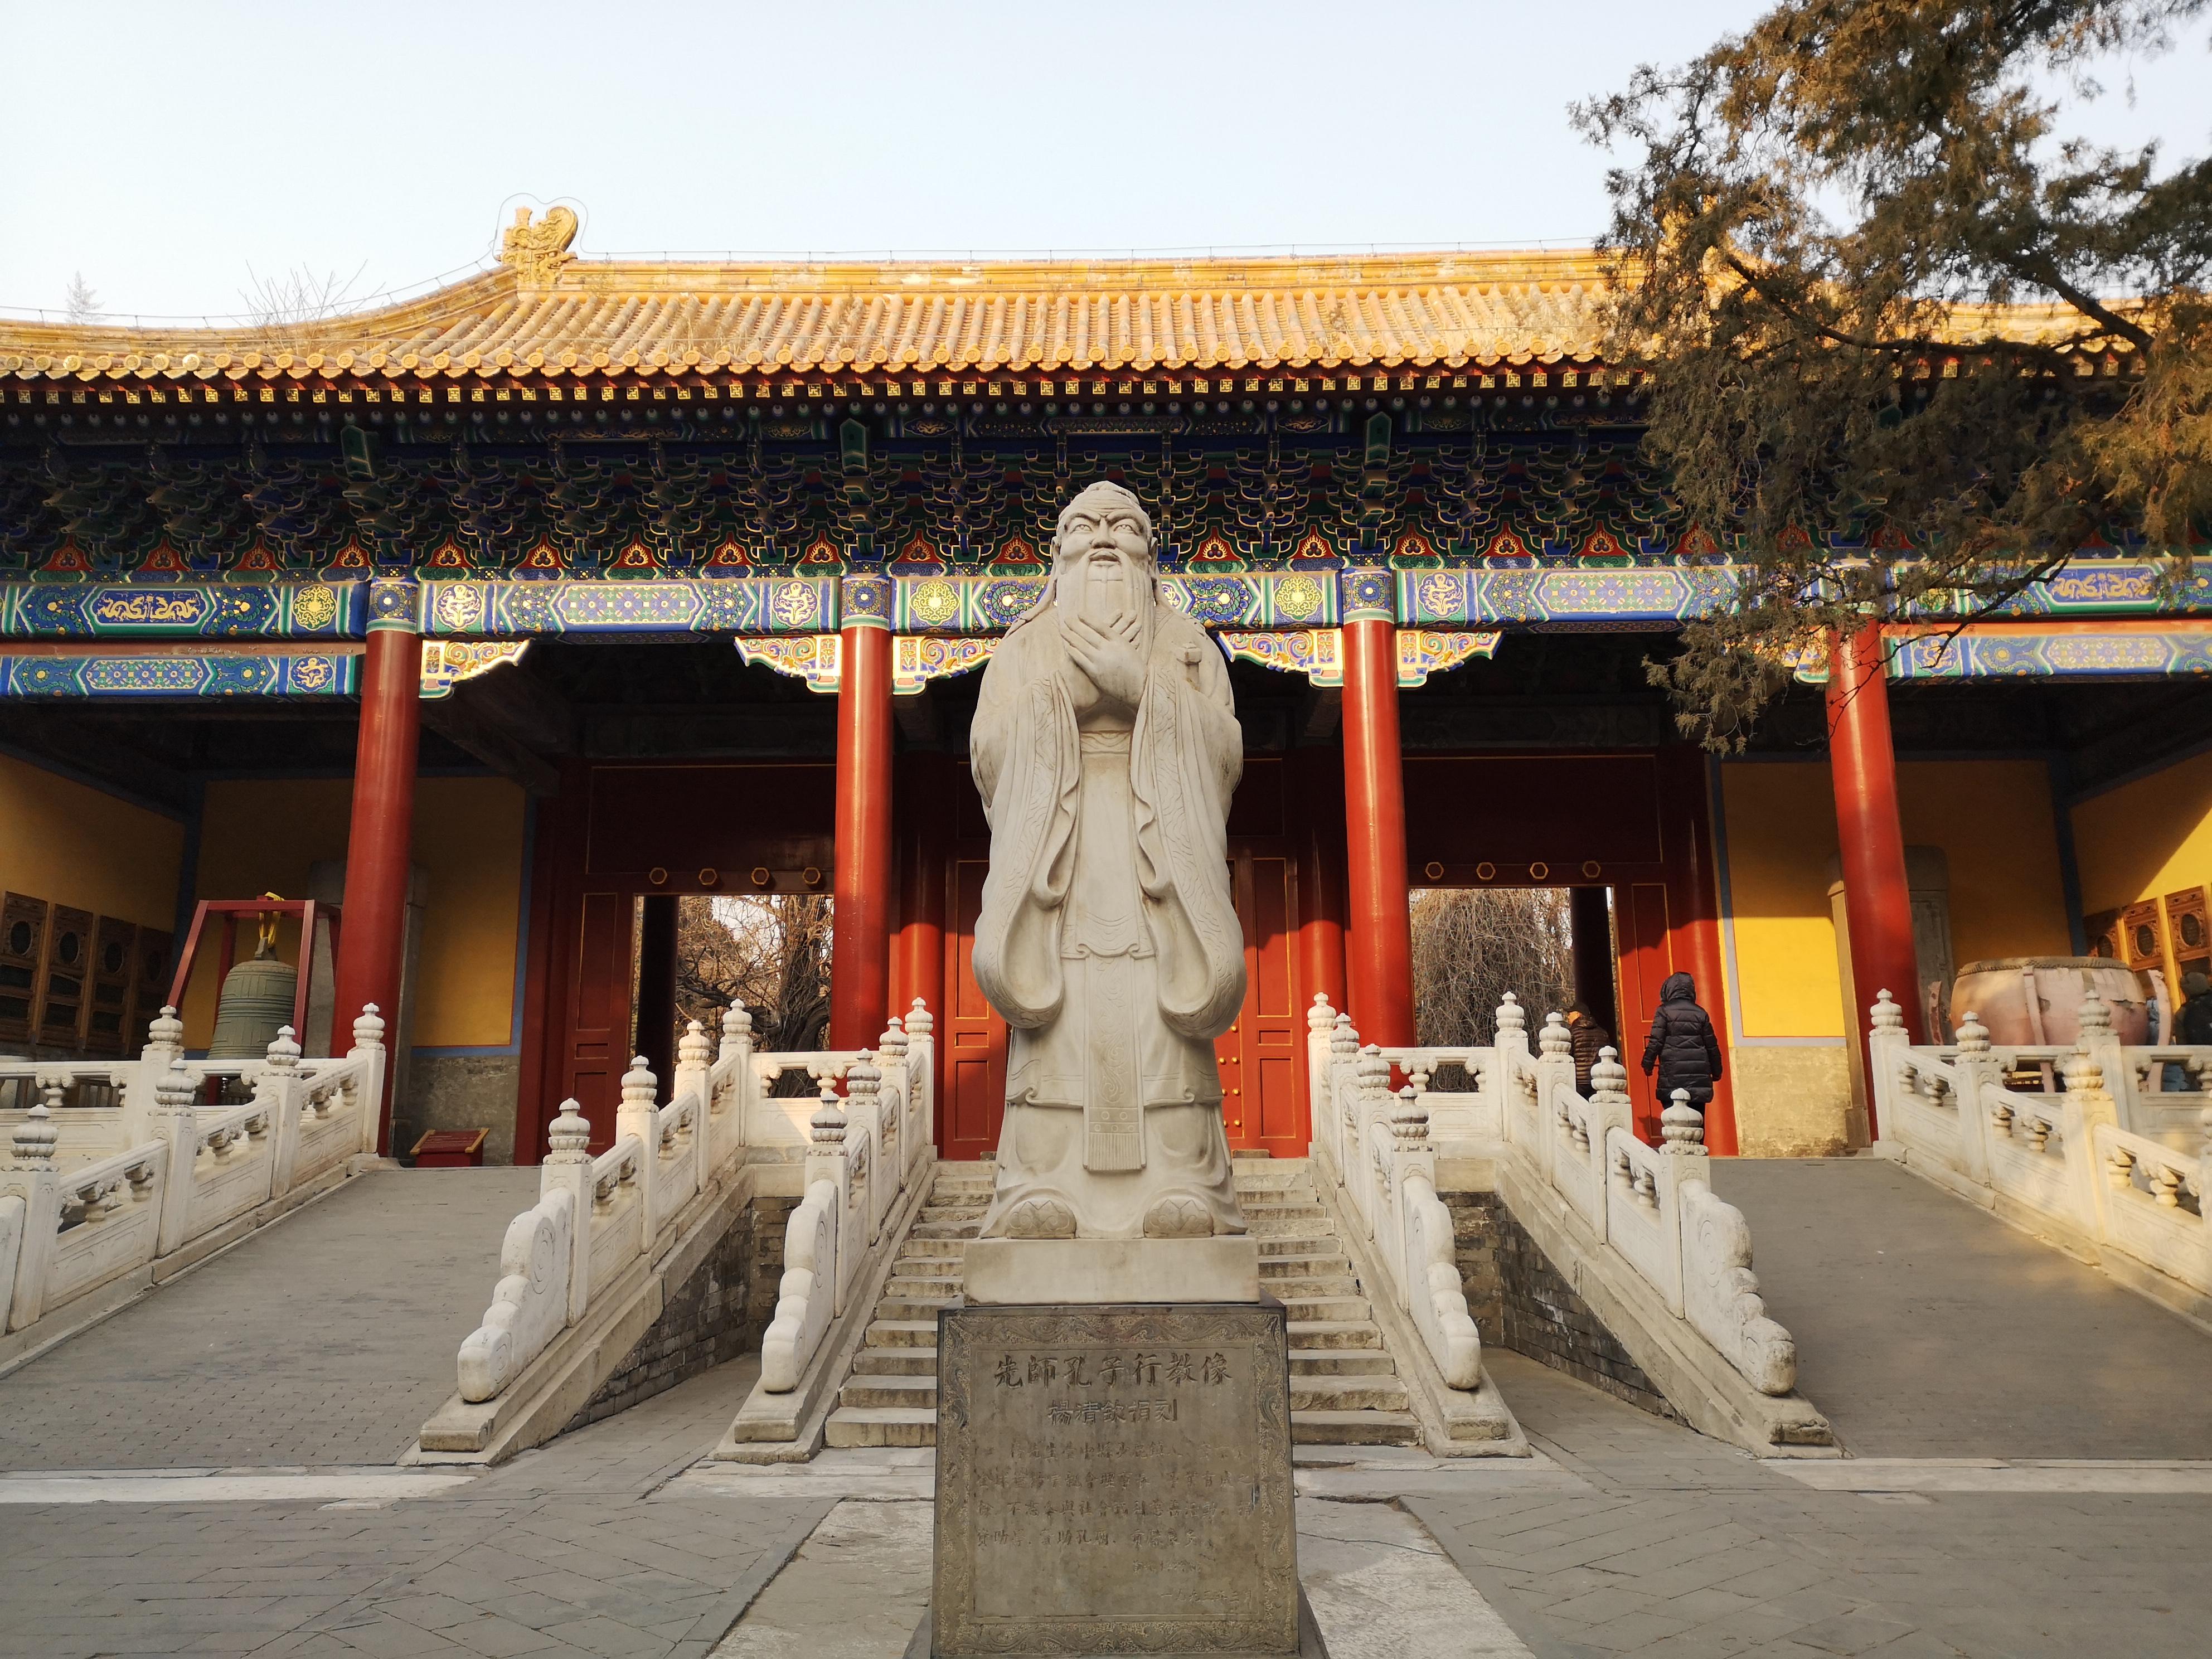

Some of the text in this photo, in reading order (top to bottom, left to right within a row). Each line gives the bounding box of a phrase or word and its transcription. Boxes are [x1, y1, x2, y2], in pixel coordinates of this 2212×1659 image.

[994, 1352, 1233, 1390] 先師孔子行教像
[1047, 1399, 1177, 1425] 楊清欽捐刻
